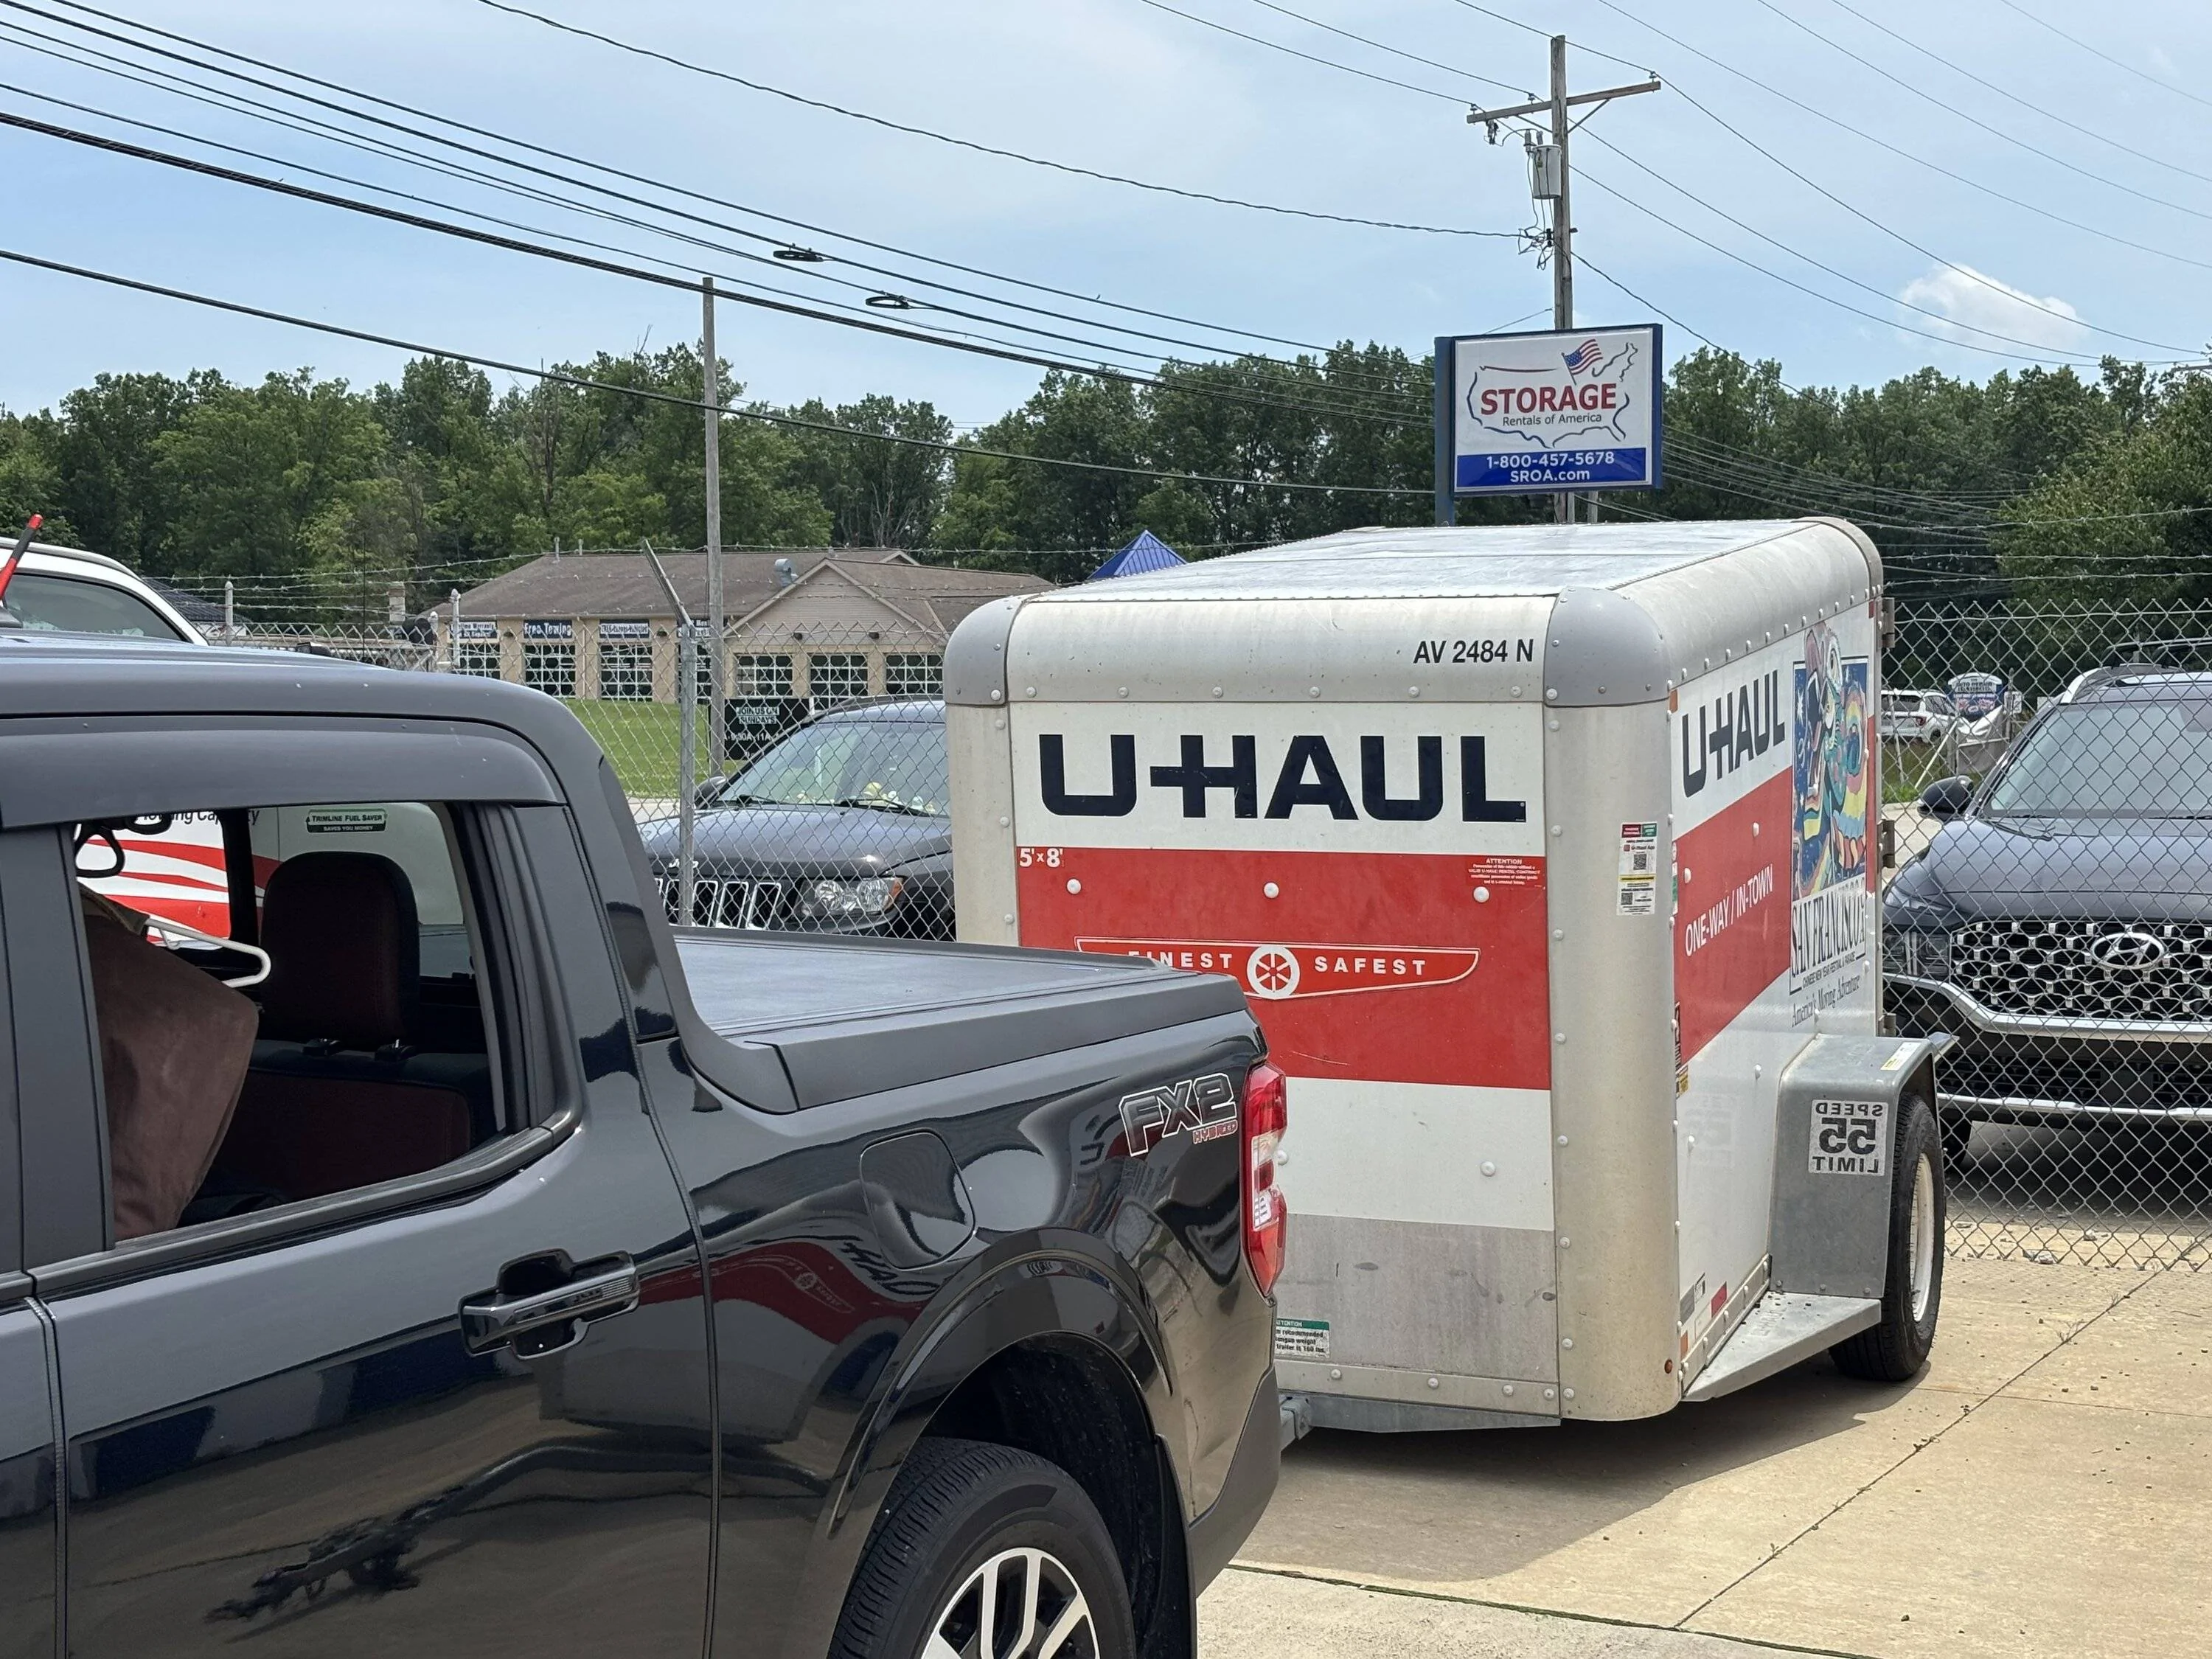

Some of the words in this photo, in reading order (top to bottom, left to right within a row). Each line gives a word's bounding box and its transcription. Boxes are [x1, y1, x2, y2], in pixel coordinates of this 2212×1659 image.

[1481, 383, 1617, 415] STORAGE
[1503, 415, 1541, 426] Rentals
[1545, 414, 1556, 424] of
[1559, 413, 1601, 424] America
[1486, 451, 1615, 469] 1-800-457-5678
[1510, 470, 1590, 482] SROA.com
[1413, 641, 1447, 664] AV
[1453, 640, 1508, 663] 2484
[1517, 639, 1534, 662] N
[1682, 669, 1785, 798] U-HAUL
[1039, 734, 1527, 823] U-HAUL
[1686, 894, 1730, 957] ONE-WAY
[1736, 863, 1773, 919] IN-TOWN
[1791, 901, 1811, 978] SAN
[1315, 956, 1427, 975] SAFEST
[1119, 1072, 1237, 1158] FX2
[1192, 1119, 1238, 1144] HYBRID
